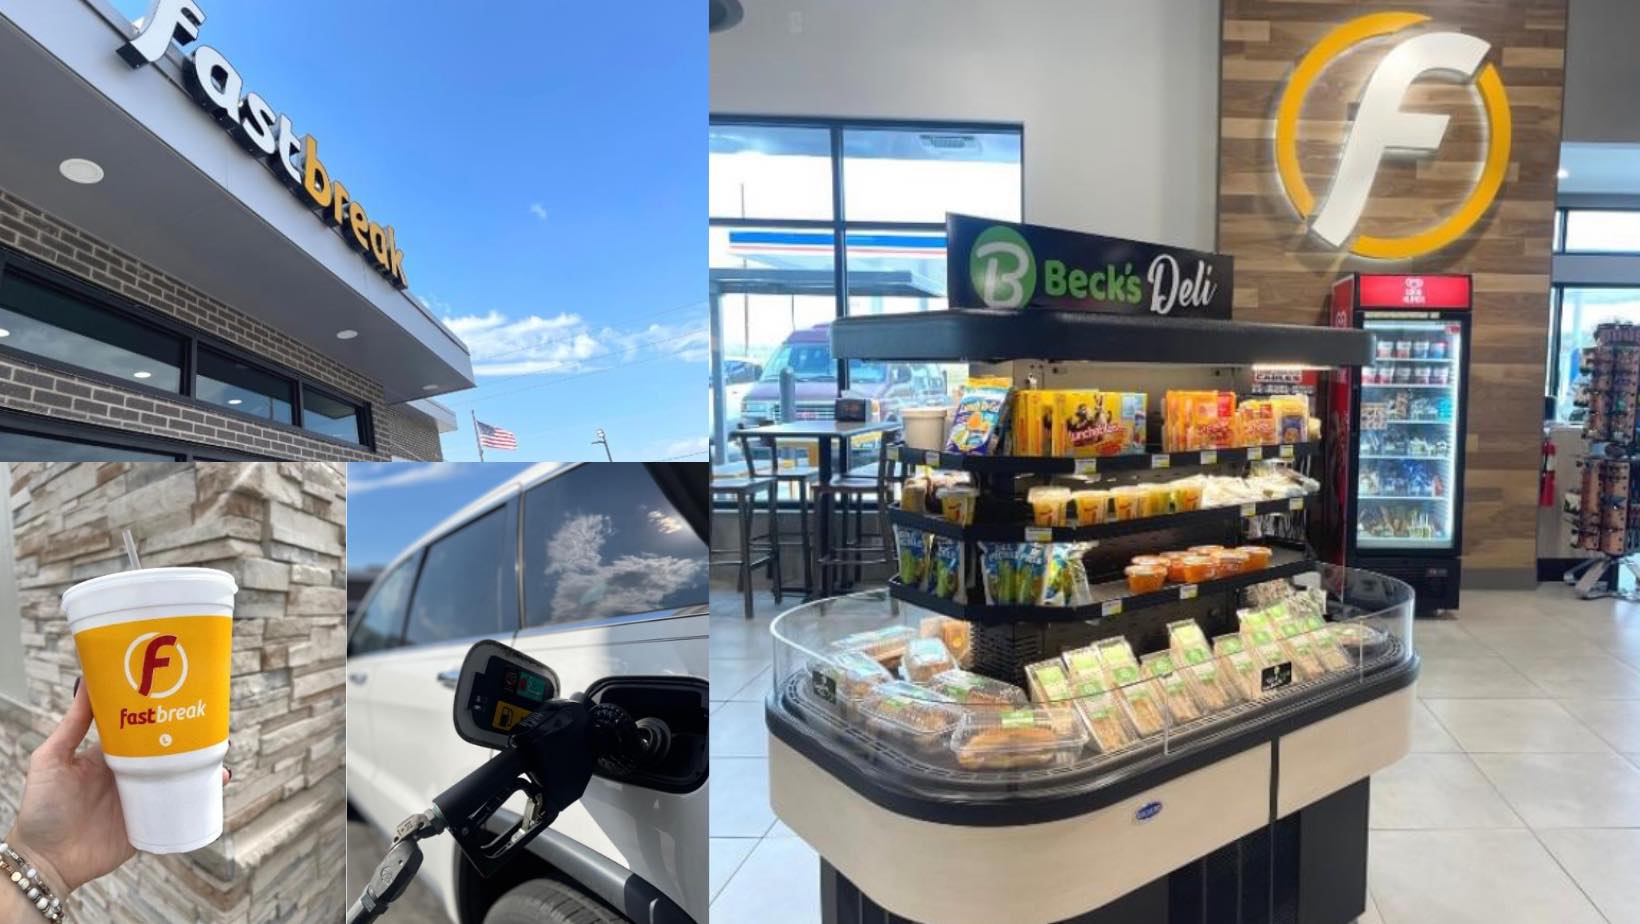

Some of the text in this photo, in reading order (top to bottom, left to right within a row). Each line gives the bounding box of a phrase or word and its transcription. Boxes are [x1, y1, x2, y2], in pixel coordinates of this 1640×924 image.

[1043, 260, 1142, 305] Beck's
[1147, 253, 1218, 315] Deli
[119, 699, 207, 730] fastbreak
